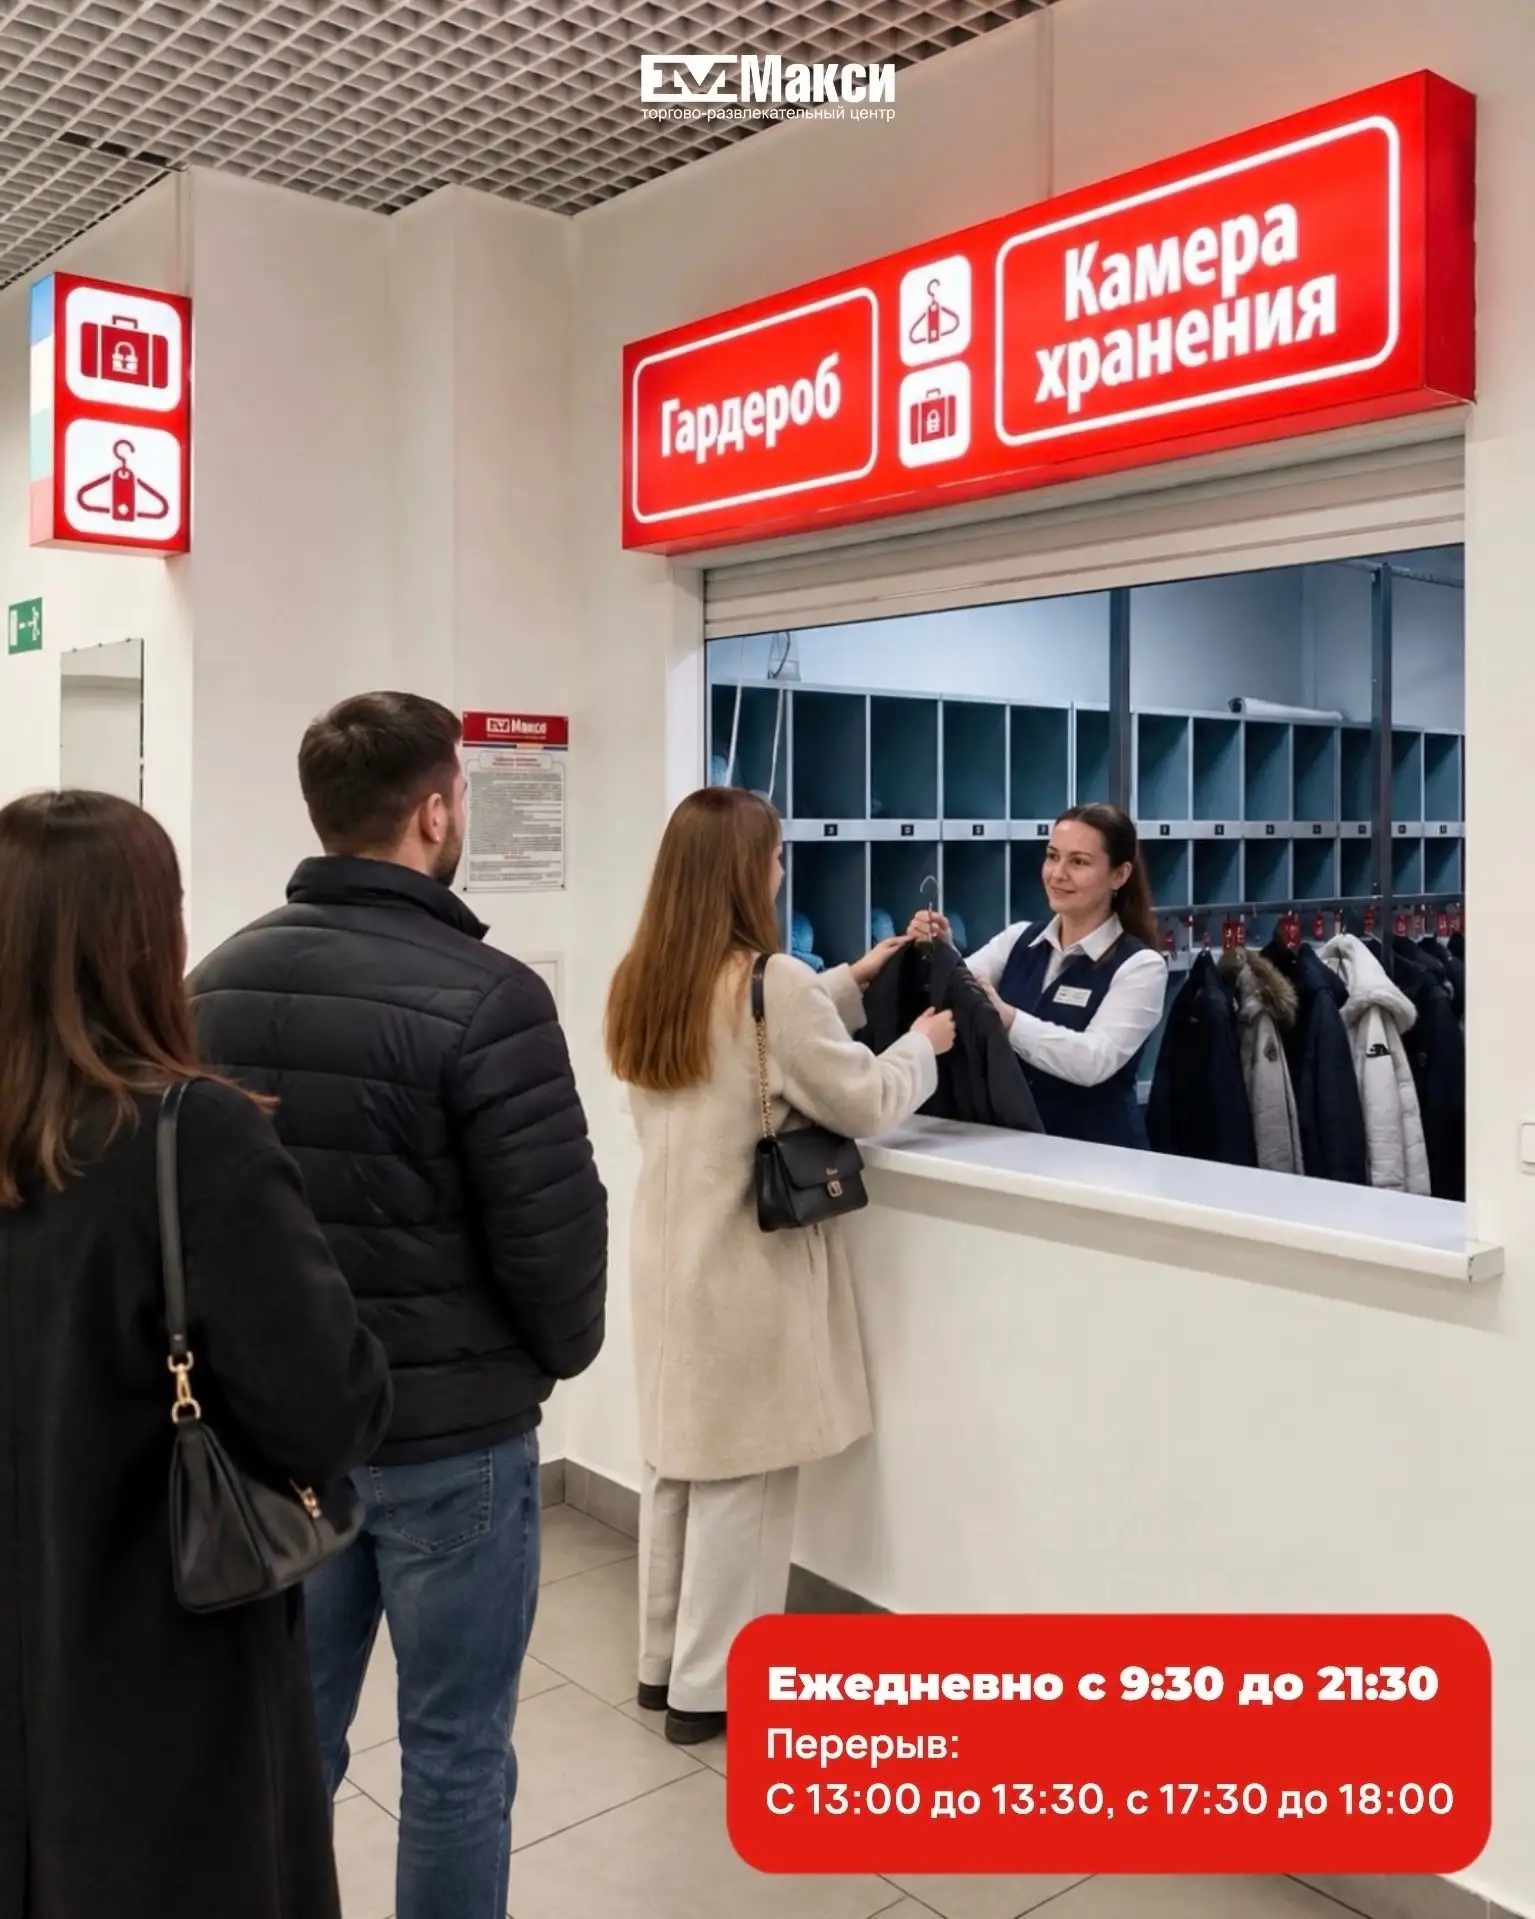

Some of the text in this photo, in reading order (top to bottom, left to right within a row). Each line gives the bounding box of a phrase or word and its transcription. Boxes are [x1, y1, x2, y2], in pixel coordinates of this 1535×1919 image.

[1064, 203, 1298, 312] Камера
[1035, 274, 1337, 414] хранения
[661, 351, 841, 465] Гардероб
